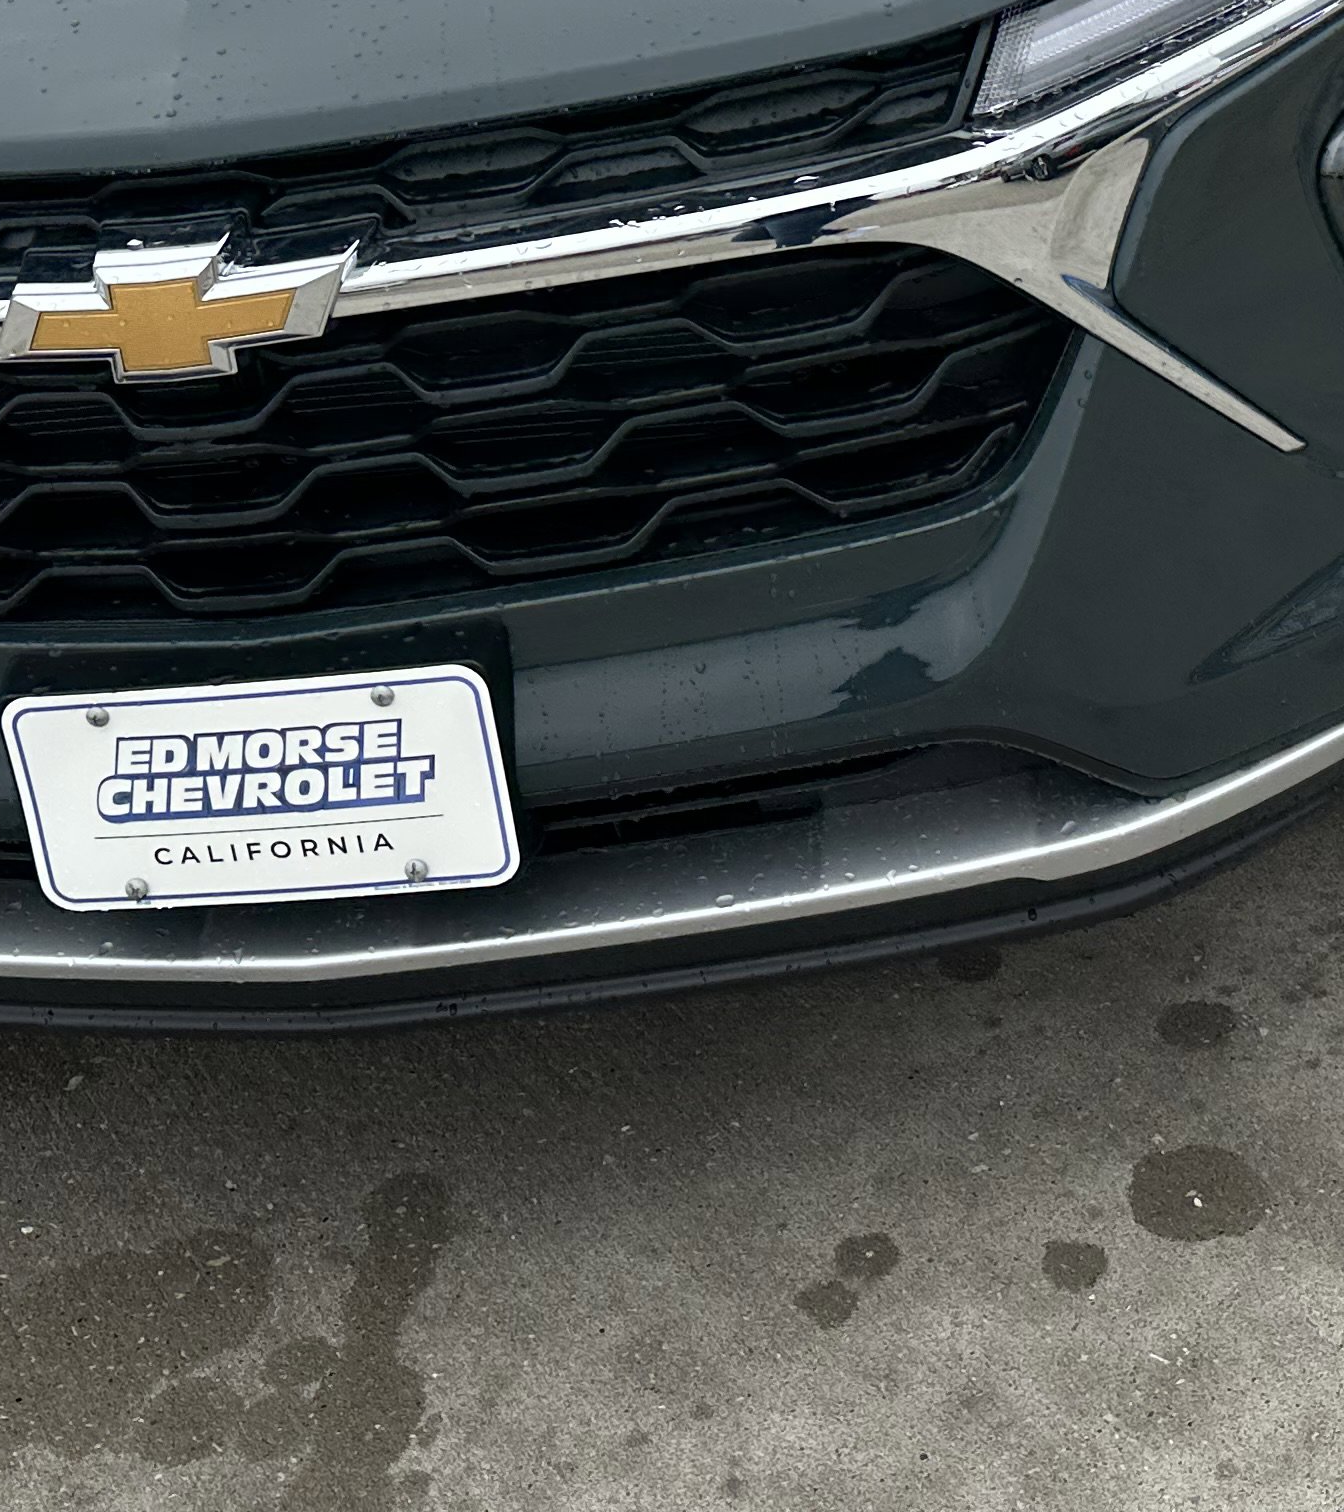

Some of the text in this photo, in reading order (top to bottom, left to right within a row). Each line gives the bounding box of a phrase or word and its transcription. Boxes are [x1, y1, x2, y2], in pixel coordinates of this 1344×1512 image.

[116, 719, 401, 775] ED MORSE
[97, 756, 434, 821] CHEVROLET
[154, 833, 394, 865] CALIFORNIA
